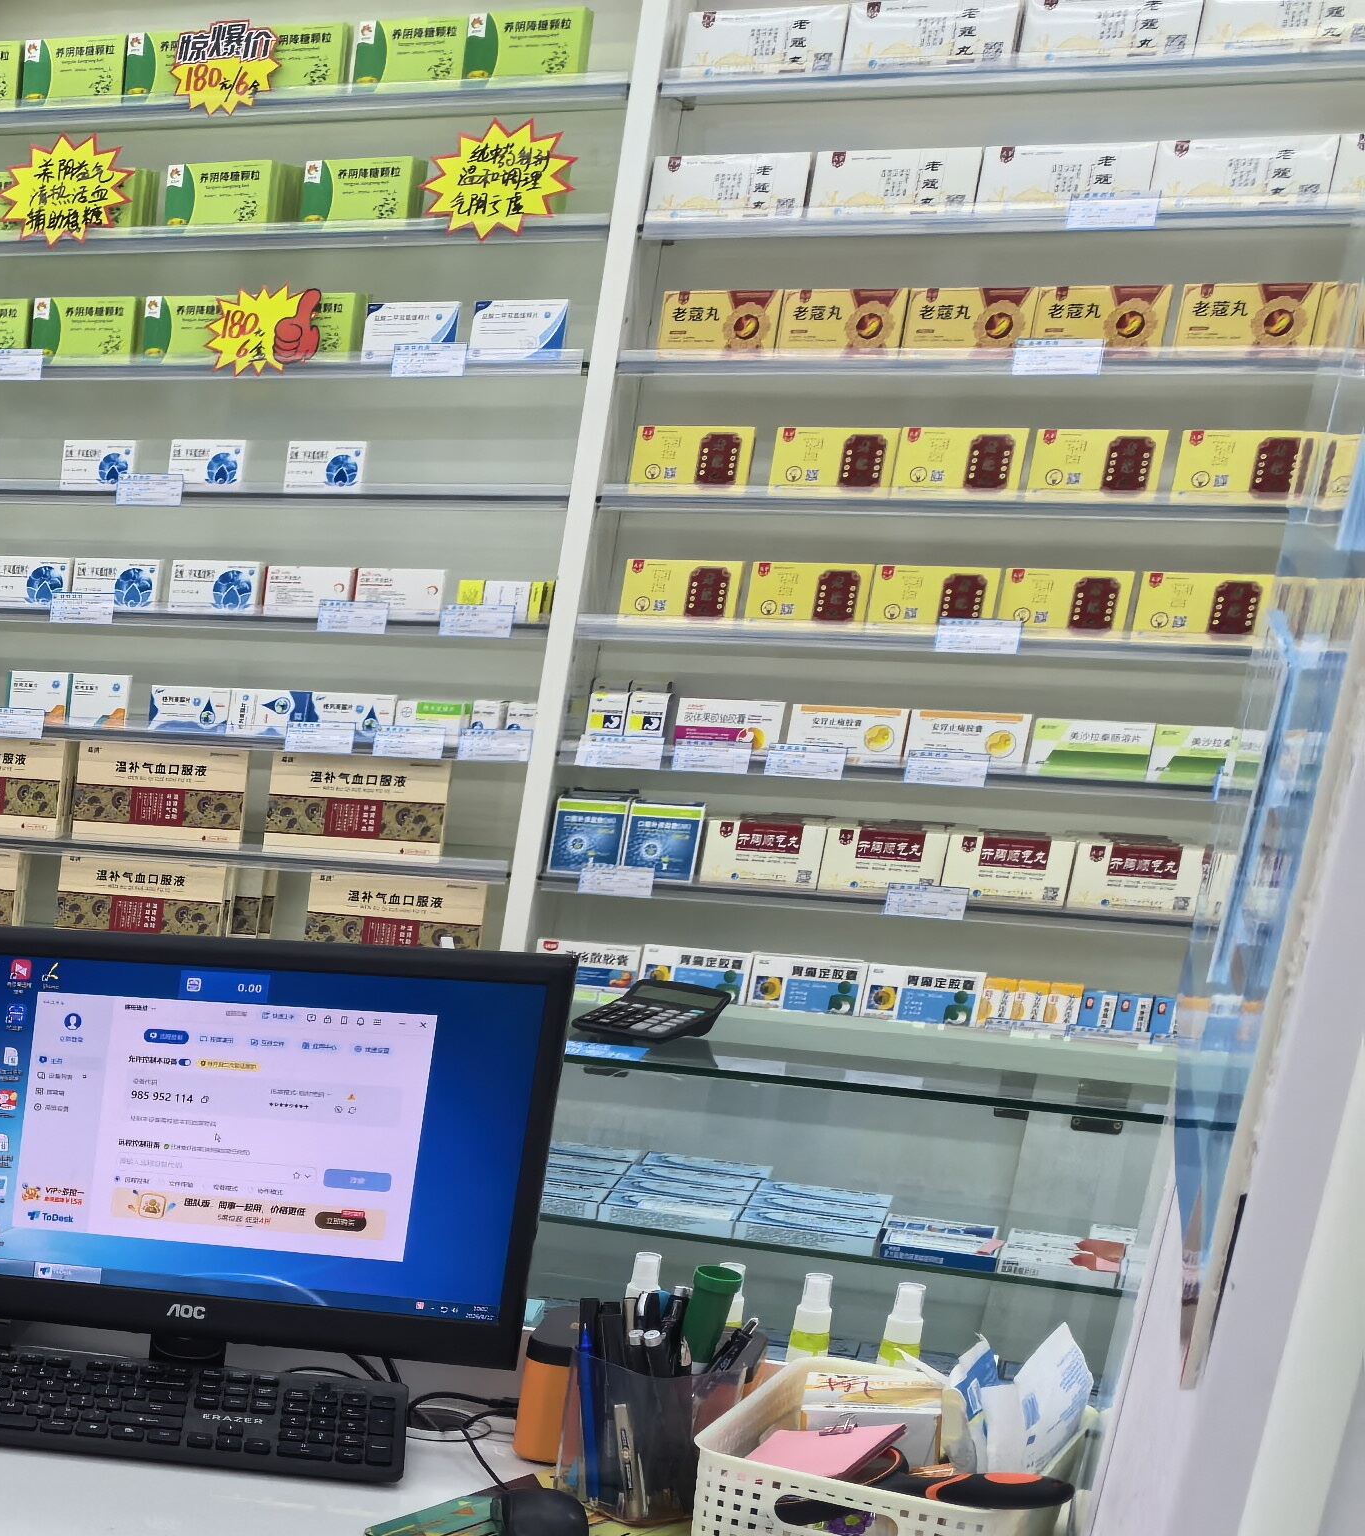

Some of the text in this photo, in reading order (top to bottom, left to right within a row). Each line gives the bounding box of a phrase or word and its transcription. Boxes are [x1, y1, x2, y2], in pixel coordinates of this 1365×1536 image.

[392, 26, 457, 40] 养阴降糖颗粒
[503, 18, 572, 32] 养阴降糖颗粒
[955, 5, 978, 59] 老蔻丸
[176, 22, 274, 64] 惊爆价
[278, 32, 332, 45] 阴降糖颗粒
[788, 18, 811, 67] 老蔻丸
[55, 44, 115, 58] 养阴降糖颗粒
[33, 158, 115, 183] 养阴益气
[199, 170, 260, 184] 养阴降糖颗粒
[337, 167, 401, 180] 养阴降糖颗粒
[457, 168, 542, 190] 温和调理
[1095, 154, 1117, 187] 老蔻
[1271, 148, 1296, 197] 老蔻丸
[30, 184, 108, 207] 清热活血
[751, 164, 774, 212] 老蔻丸
[65, 305, 125, 319] 养阴降糖颗粒
[672, 304, 720, 322] 老蔻丸
[792, 304, 842, 322] 老蔻丸
[919, 303, 970, 321] 老蔻丸
[1047, 302, 1101, 320] 老蔻丸
[1192, 300, 1249, 318] 老蔻丸
[1070, 730, 1141, 744] 美沙拉秦肠溶片
[115, 760, 208, 778] 温补气血口服液
[310, 770, 408, 788] 温补气血口服液
[737, 833, 799, 848] 开胸顺气丸
[858, 841, 922, 856] 开胸顺气丸
[981, 848, 1047, 864] 开胸顺气丸
[1110, 857, 1179, 874] 开胸顺气丸
[96, 869, 186, 887] 温补气血口服液
[348, 890, 444, 908] 温补气血口服液
[237, 982, 262, 994] 0.00
[128, 1055, 178, 1066] 允许控制本设备
[130, 1090, 194, 1104] 985 952 114
[41, 1211, 74, 1224] ToDesk
[166, 1303, 206, 1321] AOC
